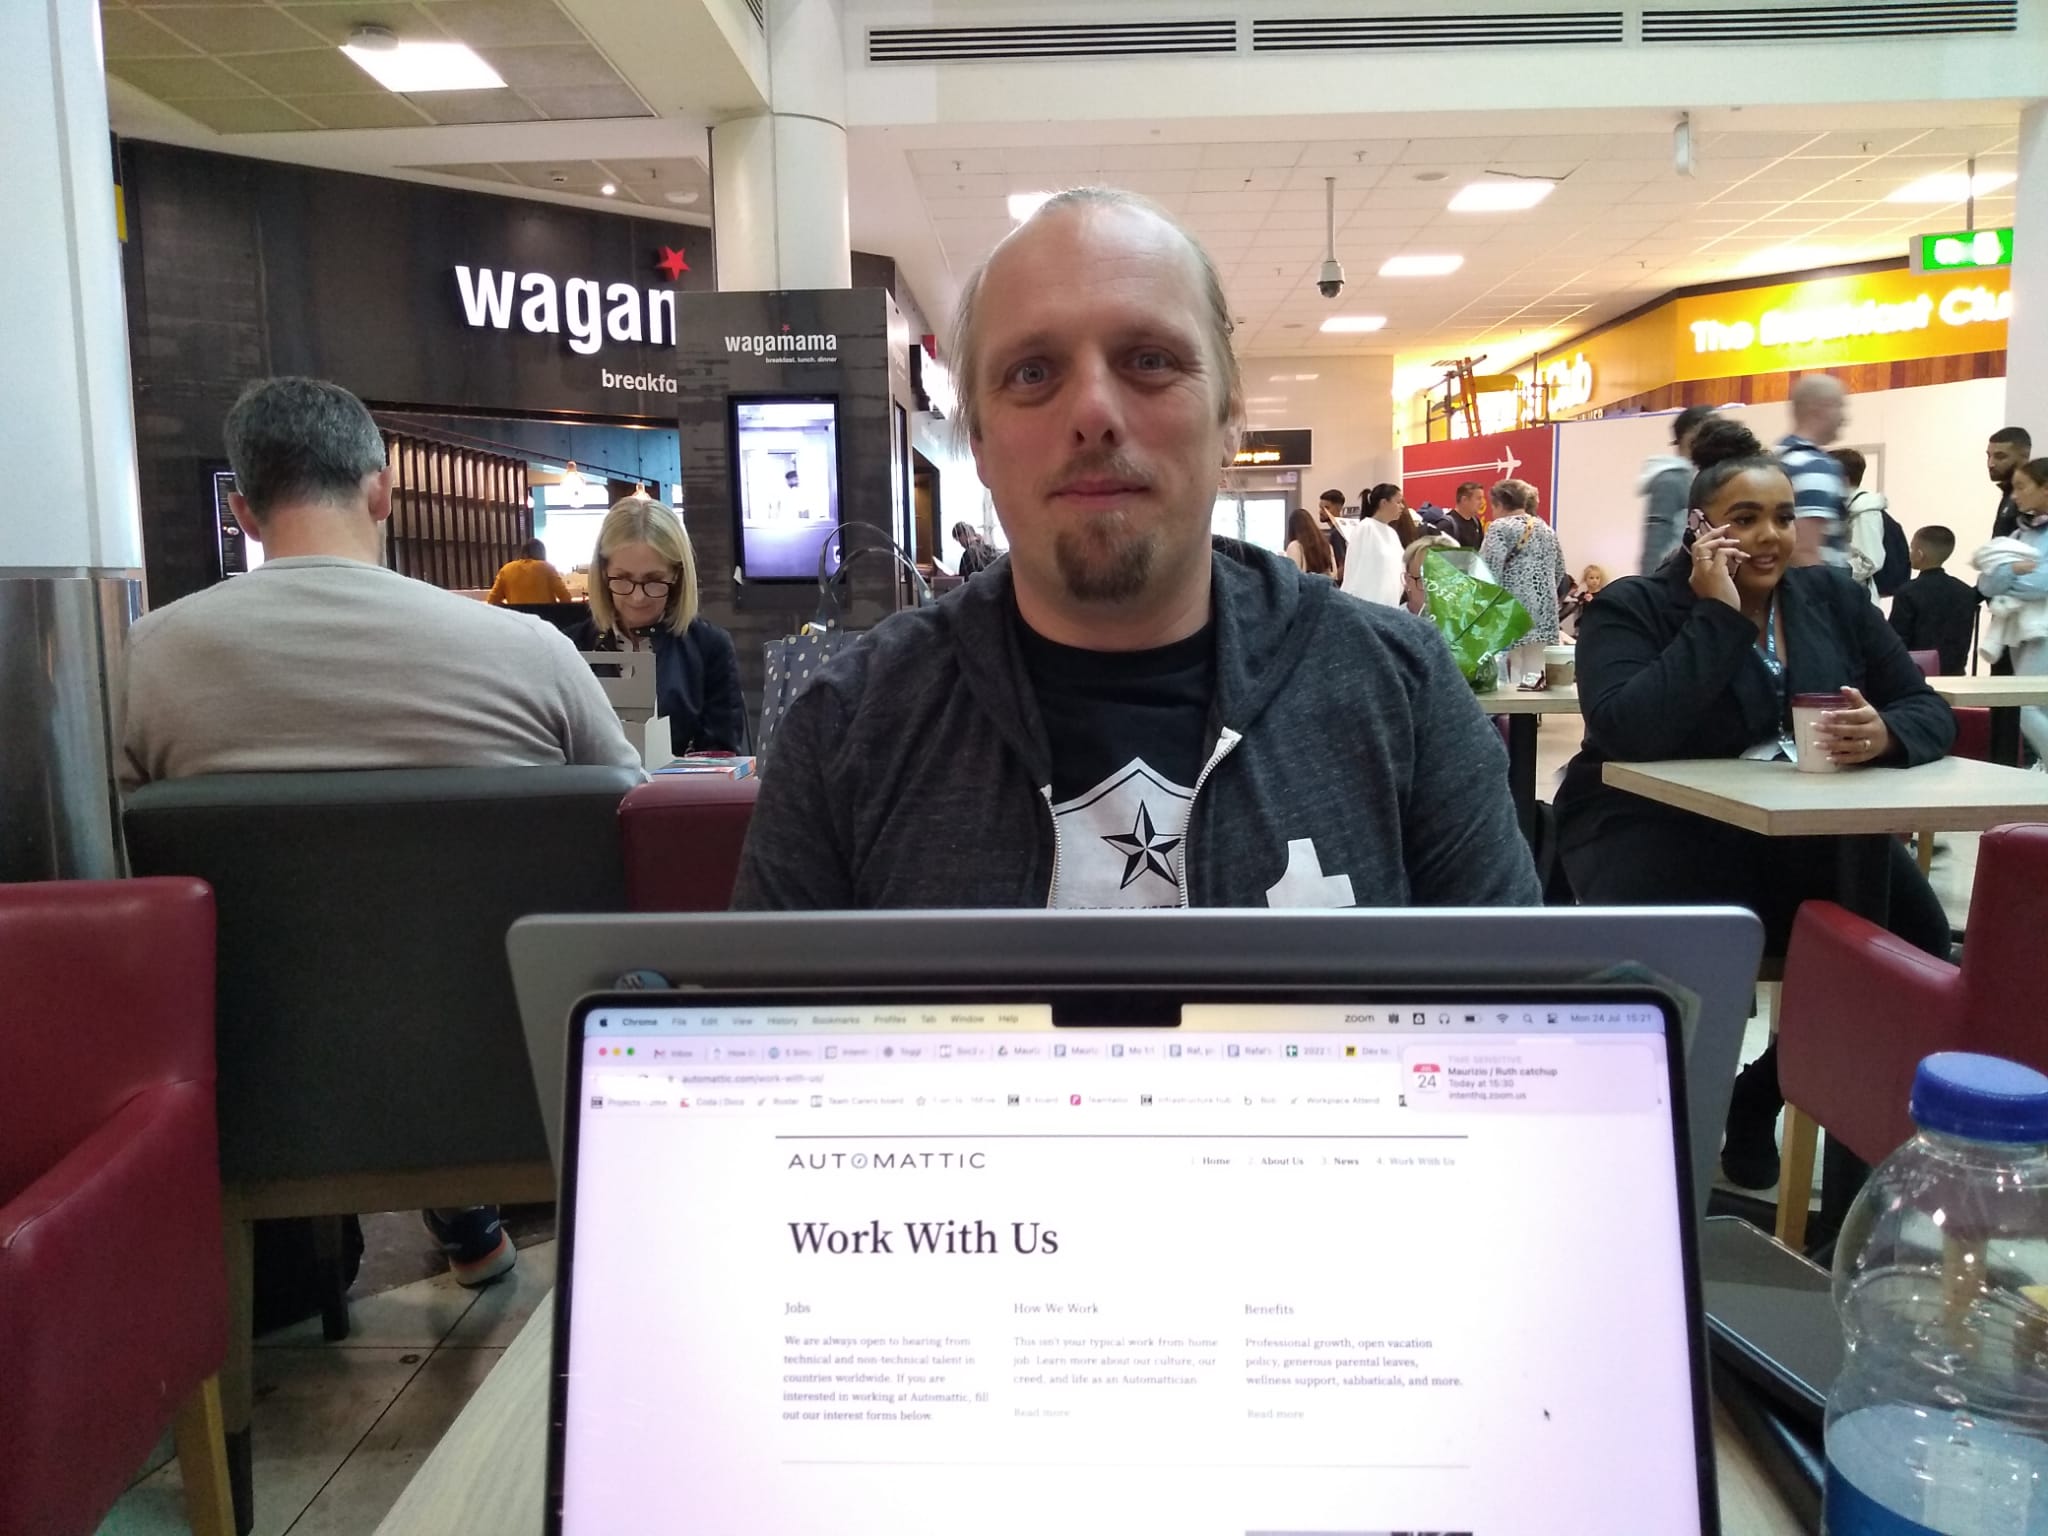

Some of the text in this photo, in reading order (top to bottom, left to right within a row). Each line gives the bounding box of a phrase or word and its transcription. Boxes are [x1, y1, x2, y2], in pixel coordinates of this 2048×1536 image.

[725, 334, 837, 356] wagamama
[622, 1014, 1019, 1027] Chrome File Edit View History Bookmarks Profiles Tab Window Help
[1345, 1014, 1375, 1023] zoom
[1570, 1014, 1591, 1022] Mon
[1592, 1014, 1604, 1023] 24
[1607, 1014, 1621, 1023] Jul
[1448, 1068, 1488, 1076] Maurizio
[1495, 1067, 1517, 1076] Ruth
[1520, 1068, 1558, 1077] catchup
[1417, 1074, 1437, 1088] 24
[1448, 1079, 1475, 1088] Today
[788, 1153, 986, 1170] AUTOMATTIC
[1203, 1157, 1230, 1165] Home
[1262, 1157, 1304, 1165] About Us
[1389, 1157, 1414, 1165] Work
[788, 1220, 1058, 1255] Work With Us
[784, 1302, 811, 1315] Jobs
[1014, 1303, 1098, 1314] How We Work
[1245, 1304, 1294, 1315] Benefits
[784, 1336, 800, 1345] We
[822, 1337, 857, 1348] always
[860, 1338, 886, 1348] open
[902, 1337, 942, 1348] hearing
[945, 1337, 971, 1346] from
[1014, 1336, 1033, 1346] This
[1090, 1338, 1125, 1349] typical
[1128, 1338, 1154, 1346] work
[1158, 1338, 1184, 1347] from
[1188, 1338, 1218, 1347] home
[1245, 1338, 1310, 1347] Professional
[1358, 1341, 1384, 1350] open
[1388, 1339, 1432, 1348] vacation
[784, 1354, 831, 1364] technical
[834, 1355, 854, 1364] and
[857, 1356, 929, 1364] non-technical
[932, 1356, 962, 1364] talent
[1037, 1356, 1066, 1365] Learn
[1100, 1356, 1130, 1365] about
[1198, 1358, 1216, 1366] our
[1283, 1359, 1332, 1368] generous
[1336, 1358, 1380, 1368] parental
[1383, 1358, 1418, 1367] leaves,
[783, 1374, 832, 1383] countries
[907, 1376, 926, 1387] you
[1049, 1374, 1068, 1384] and
[1072, 1374, 1088, 1384] life
[1106, 1376, 1118, 1384] an
[1246, 1375, 1291, 1384] wellness
[1408, 1376, 1428, 1386] and
[1431, 1378, 1463, 1386] more.
[783, 1392, 835, 1401] interested
[852, 1392, 895, 1404] working
[782, 1411, 800, 1420] out
[802, 1412, 820, 1420] our
[824, 1411, 863, 1420] interest
[866, 1410, 897, 1420] forms
[1014, 1408, 1039, 1416] Read
[1248, 1409, 1304, 1419] Read more
